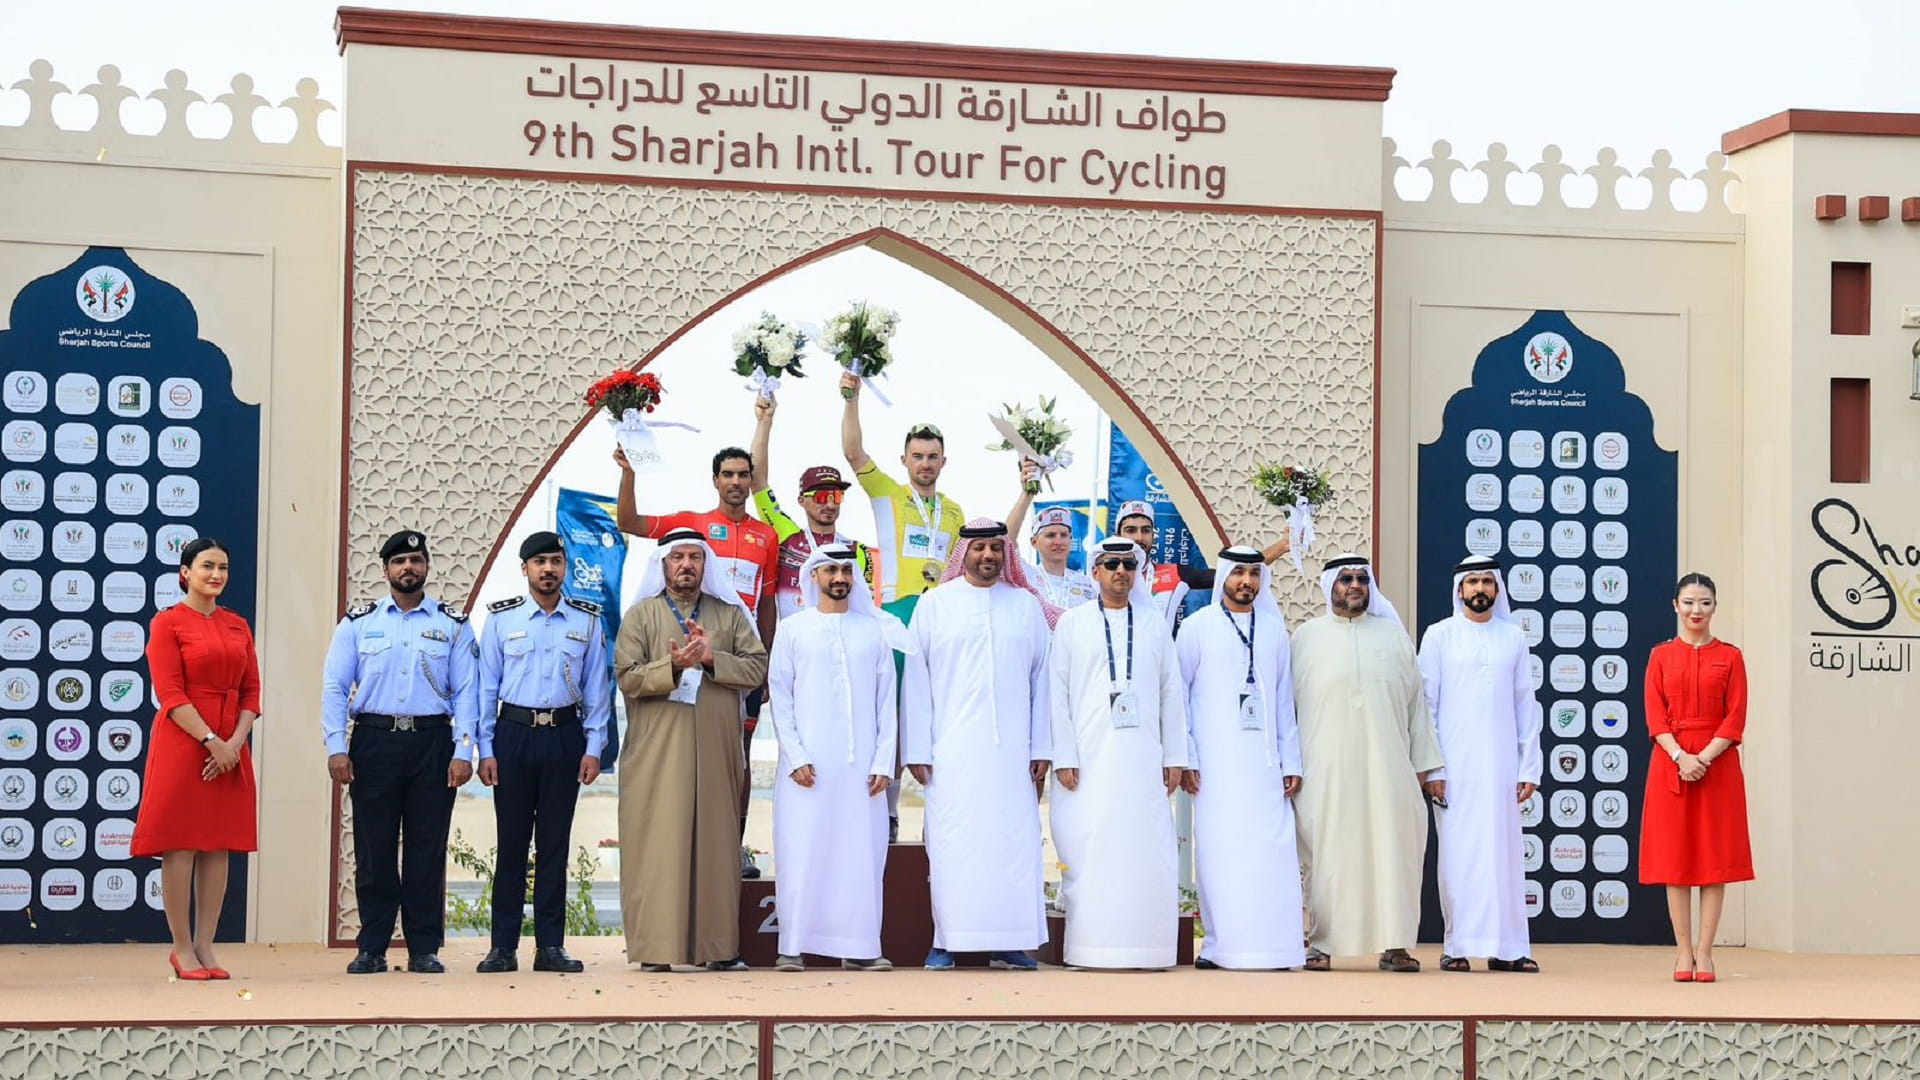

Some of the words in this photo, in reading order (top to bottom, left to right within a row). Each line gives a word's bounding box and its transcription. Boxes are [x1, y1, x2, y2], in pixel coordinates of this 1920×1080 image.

[526, 63, 684, 113] للدراجات
[696, 72, 810, 116] التاسع
[820, 79, 942, 132] الدولي
[957, 85, 1102, 133] الشارقة
[1116, 96, 1227, 143] طواف
[523, 119, 594, 160] 9th
[610, 123, 779, 175] Sharjah
[796, 134, 872, 175] Intl.
[886, 138, 985, 180] Tour
[1000, 144, 1068, 184] For
[1080, 148, 1226, 198] Cycling
[58, 337, 90, 347] Sharjah
[91, 339, 119, 348] Sports
[120, 340, 151, 348] Council
[1510, 398, 1537, 407] Sharjah
[1537, 399, 1560, 407] Sports
[1560, 399, 1586, 407] Council
[1164, 527, 1176, 545] 9th
[1811, 498, 1920, 630] Sha
[1809, 641, 1911, 678] الشارقة
[758, 895, 779, 933] 2
